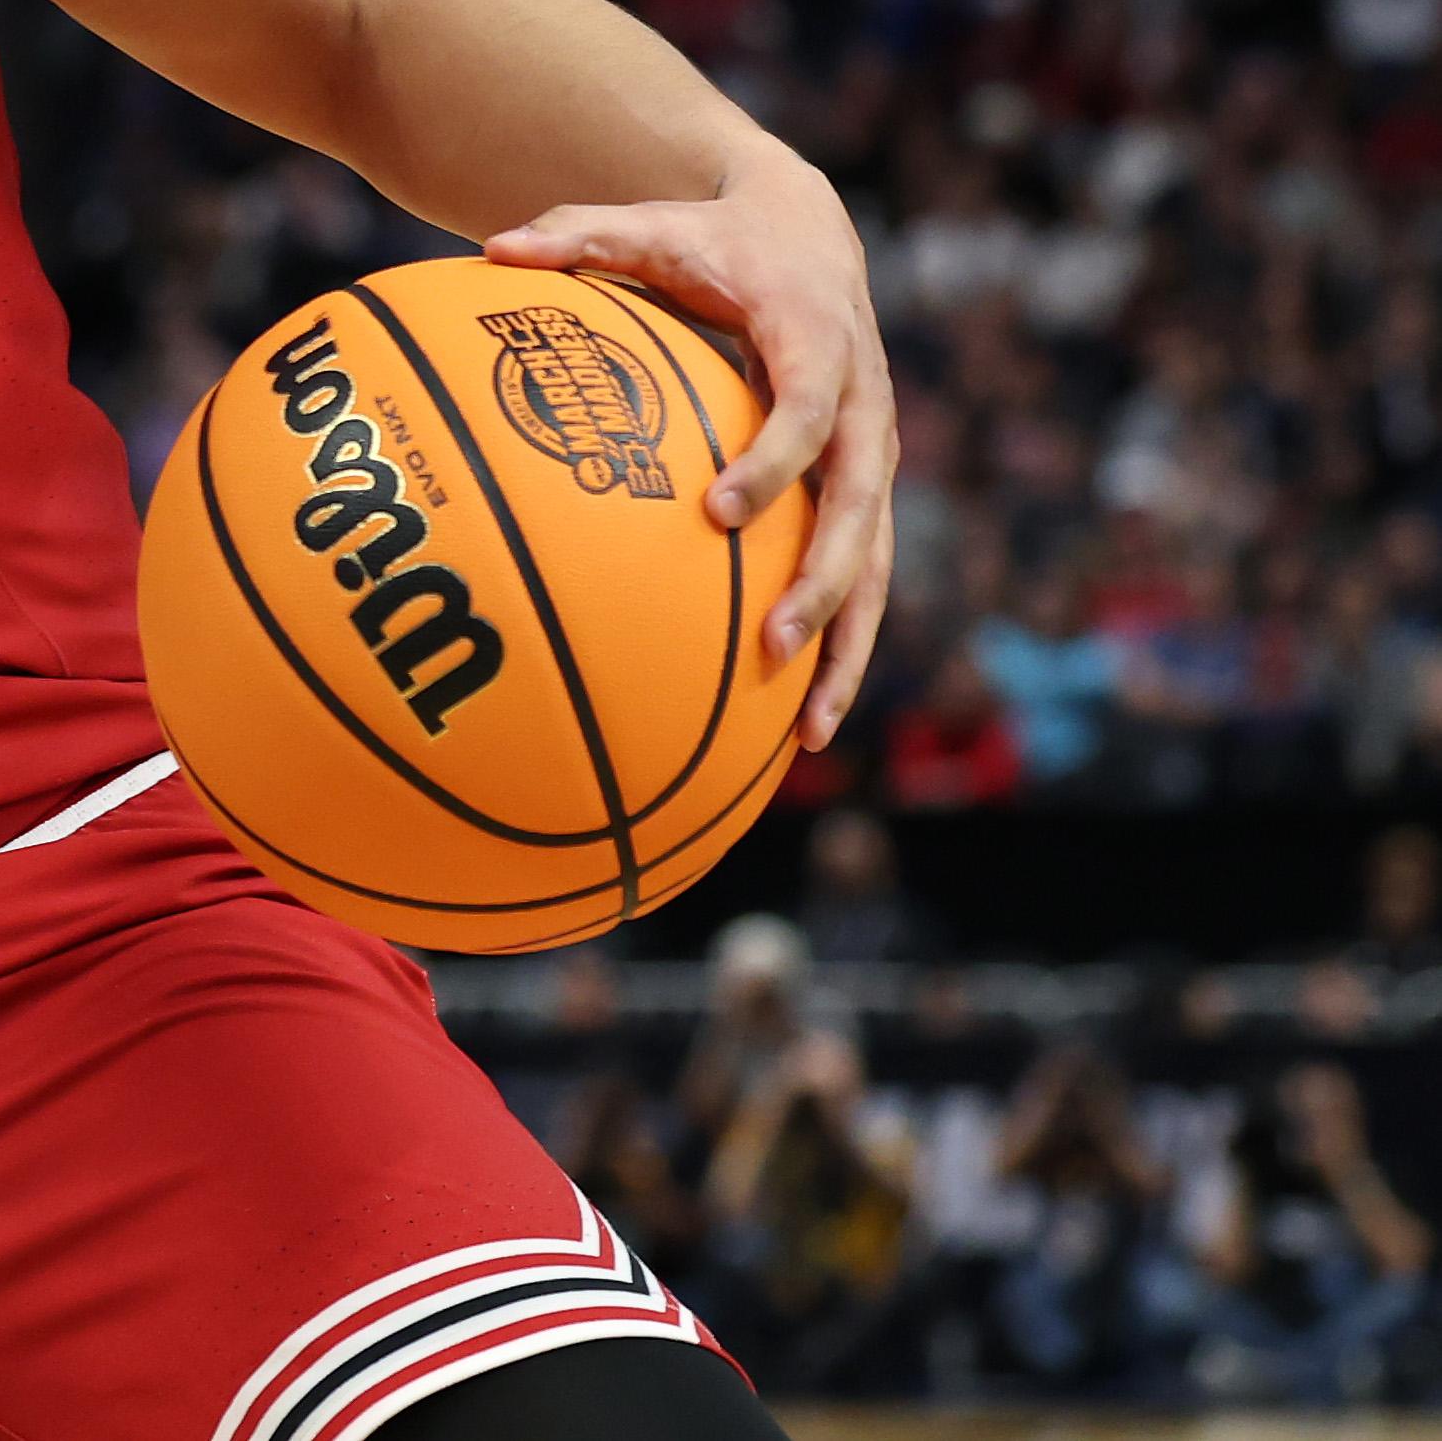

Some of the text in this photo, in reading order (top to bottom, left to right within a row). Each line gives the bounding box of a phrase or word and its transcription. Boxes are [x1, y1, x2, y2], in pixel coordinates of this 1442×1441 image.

[516, 348, 607, 455] MARCH
[522, 306, 638, 435] MADNESS
[373, 394, 451, 510] EVO NXT
[264, 314, 505, 740] Wilson
